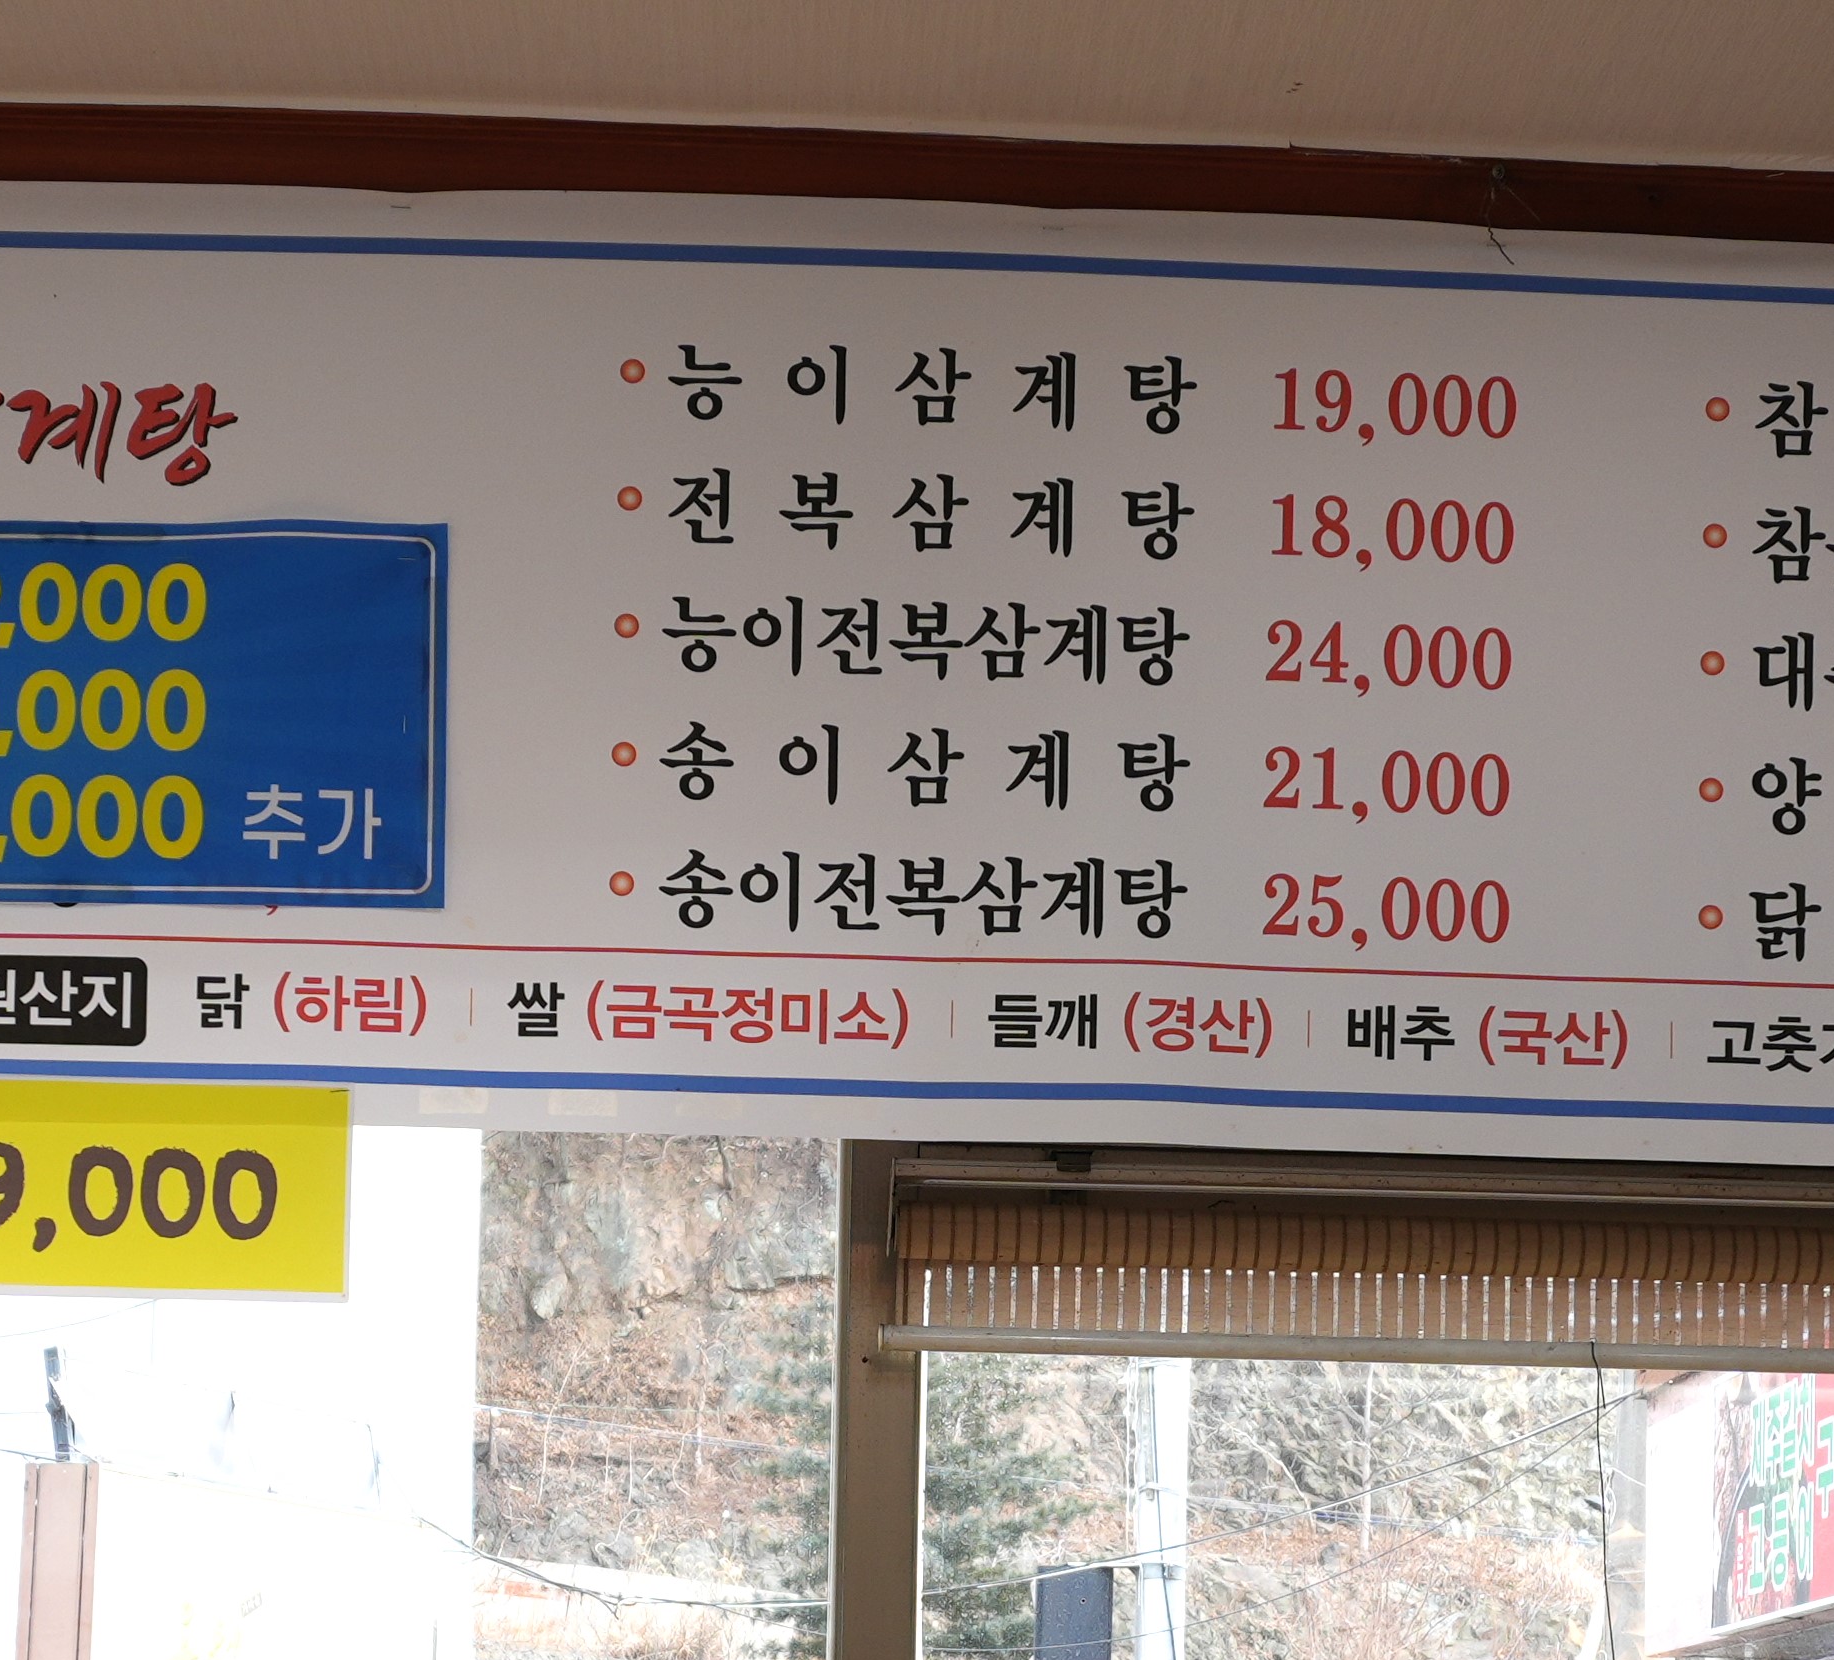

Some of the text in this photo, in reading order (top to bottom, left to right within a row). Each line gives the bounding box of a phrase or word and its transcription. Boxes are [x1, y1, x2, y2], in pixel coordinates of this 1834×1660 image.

[1274, 368, 1517, 446] 19,000
[1272, 494, 1515, 572] 18,000
[662, 596, 1512, 697] 능이전복삼계탕 24,000
[240, 783, 384, 862] 추가
[1263, 746, 1510, 824] 21,000
[659, 849, 1509, 951] 송이전복삼계탕 25,000
[196, 973, 250, 1029] 닭
[274, 971, 427, 1036] (하림)
[507, 980, 909, 1049] 쌀 (금곡정미소)
[988, 992, 1273, 1058] 들깨 (경산)
[1348, 1005, 1628, 1069] 배추 (국산)
